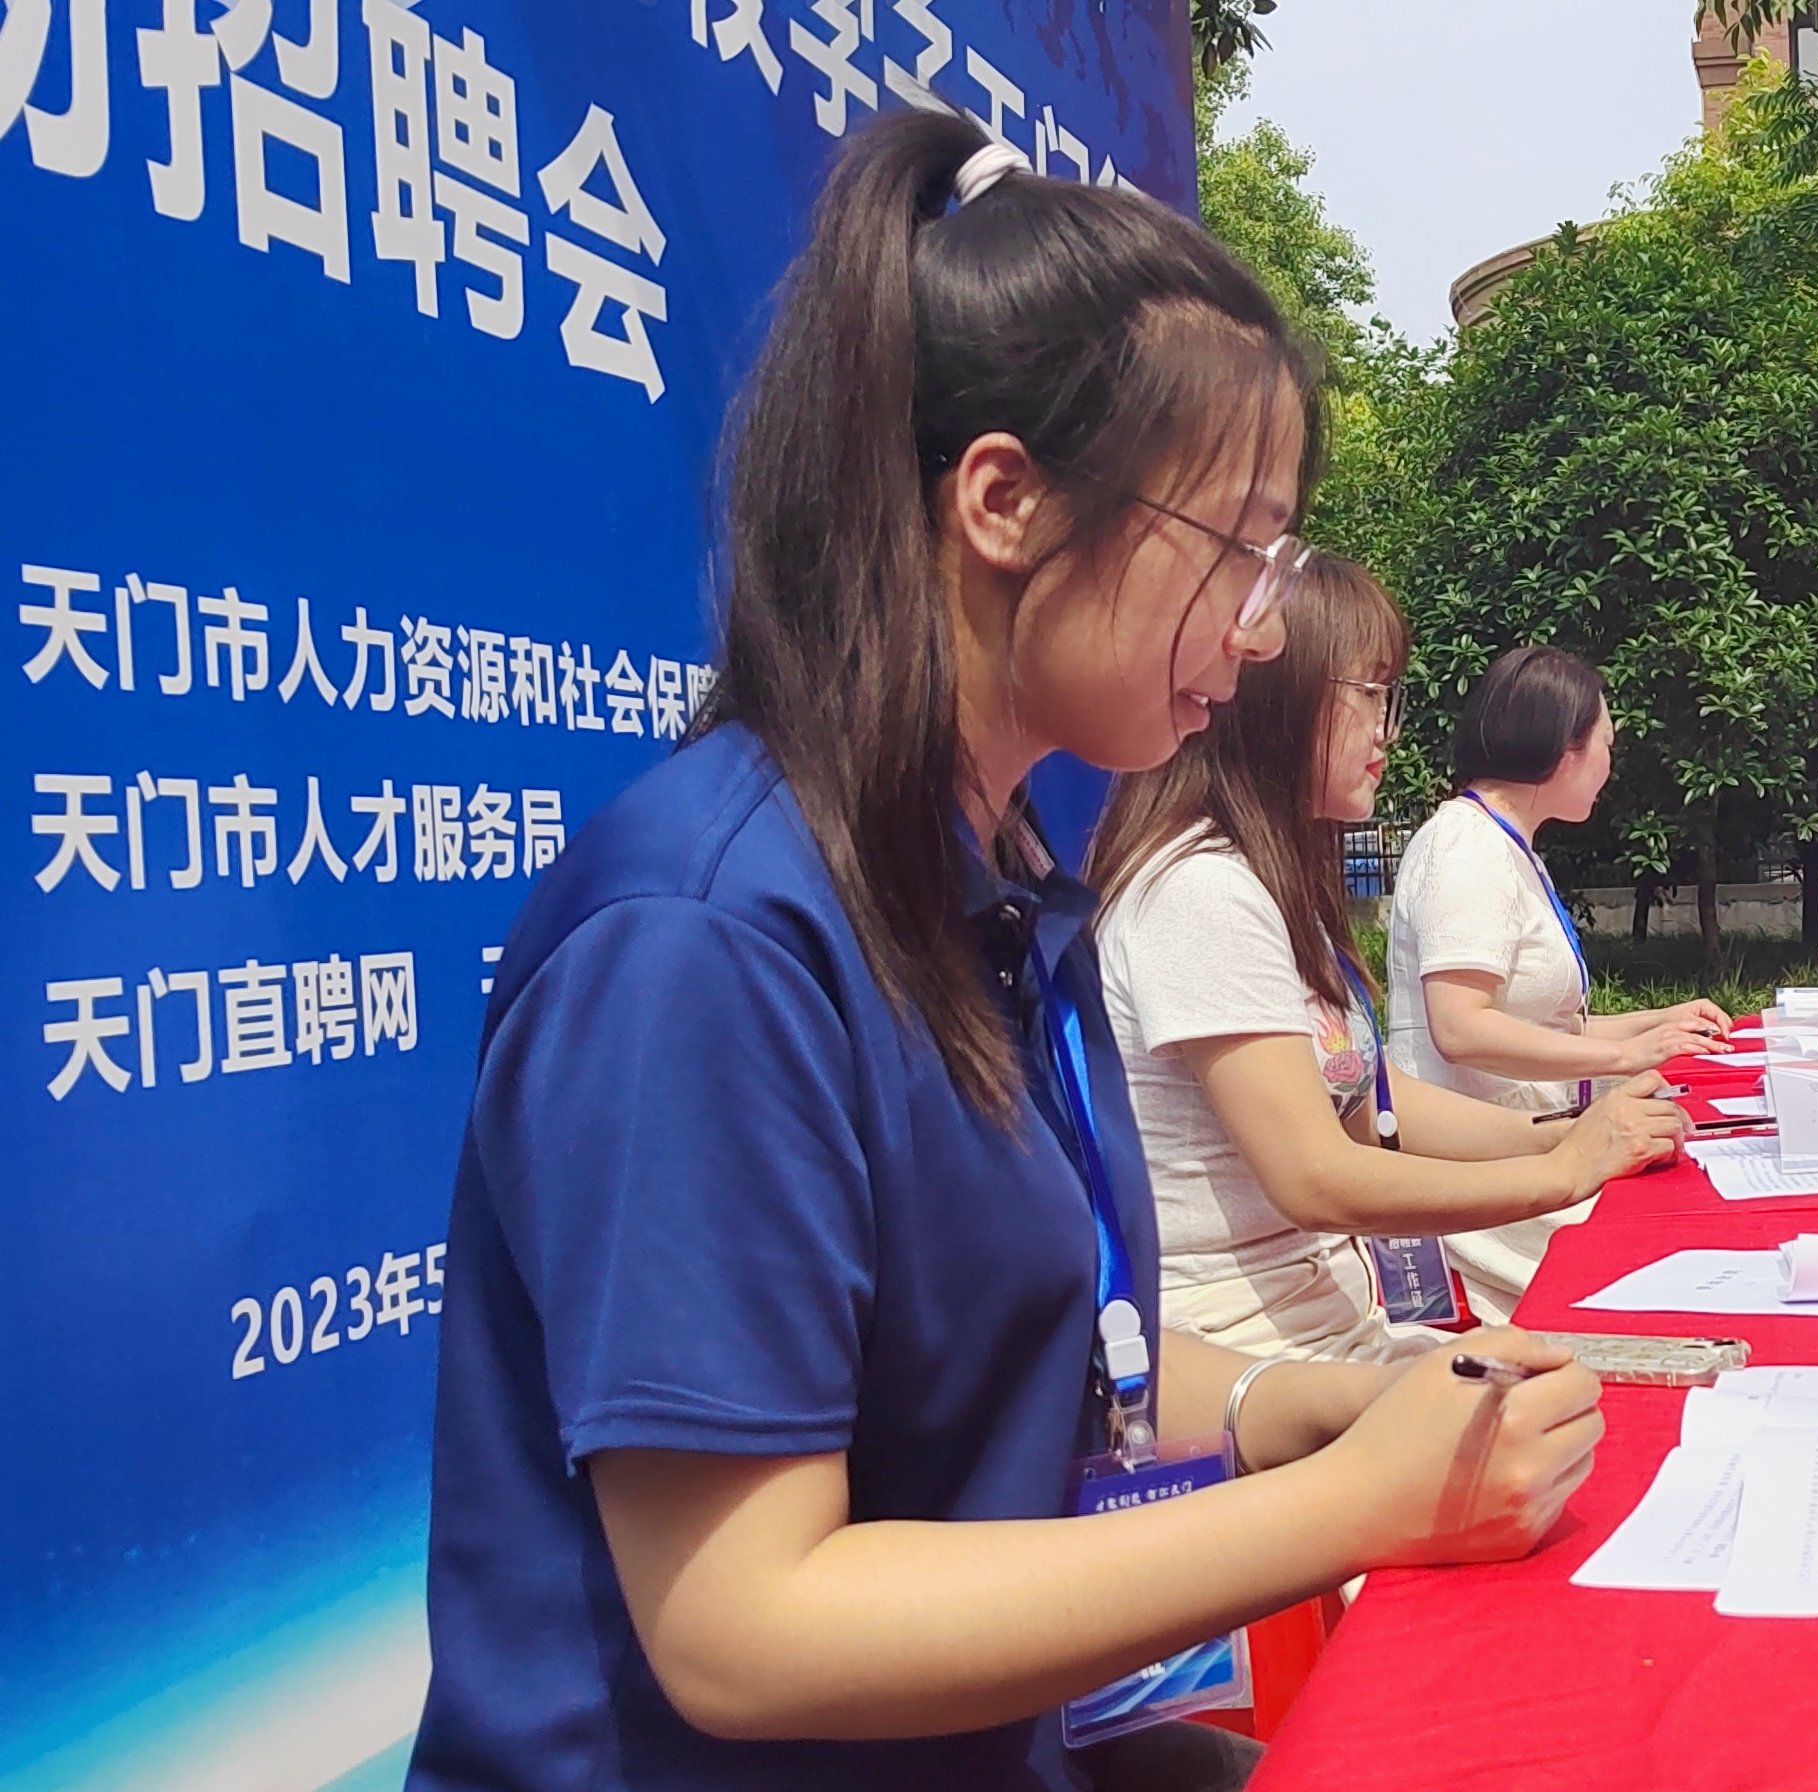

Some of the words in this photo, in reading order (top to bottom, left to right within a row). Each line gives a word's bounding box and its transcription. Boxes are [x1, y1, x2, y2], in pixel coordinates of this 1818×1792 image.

[31, 770, 566, 894] 天门市人才服务局
[43, 950, 418, 1101] 天门直聘网
